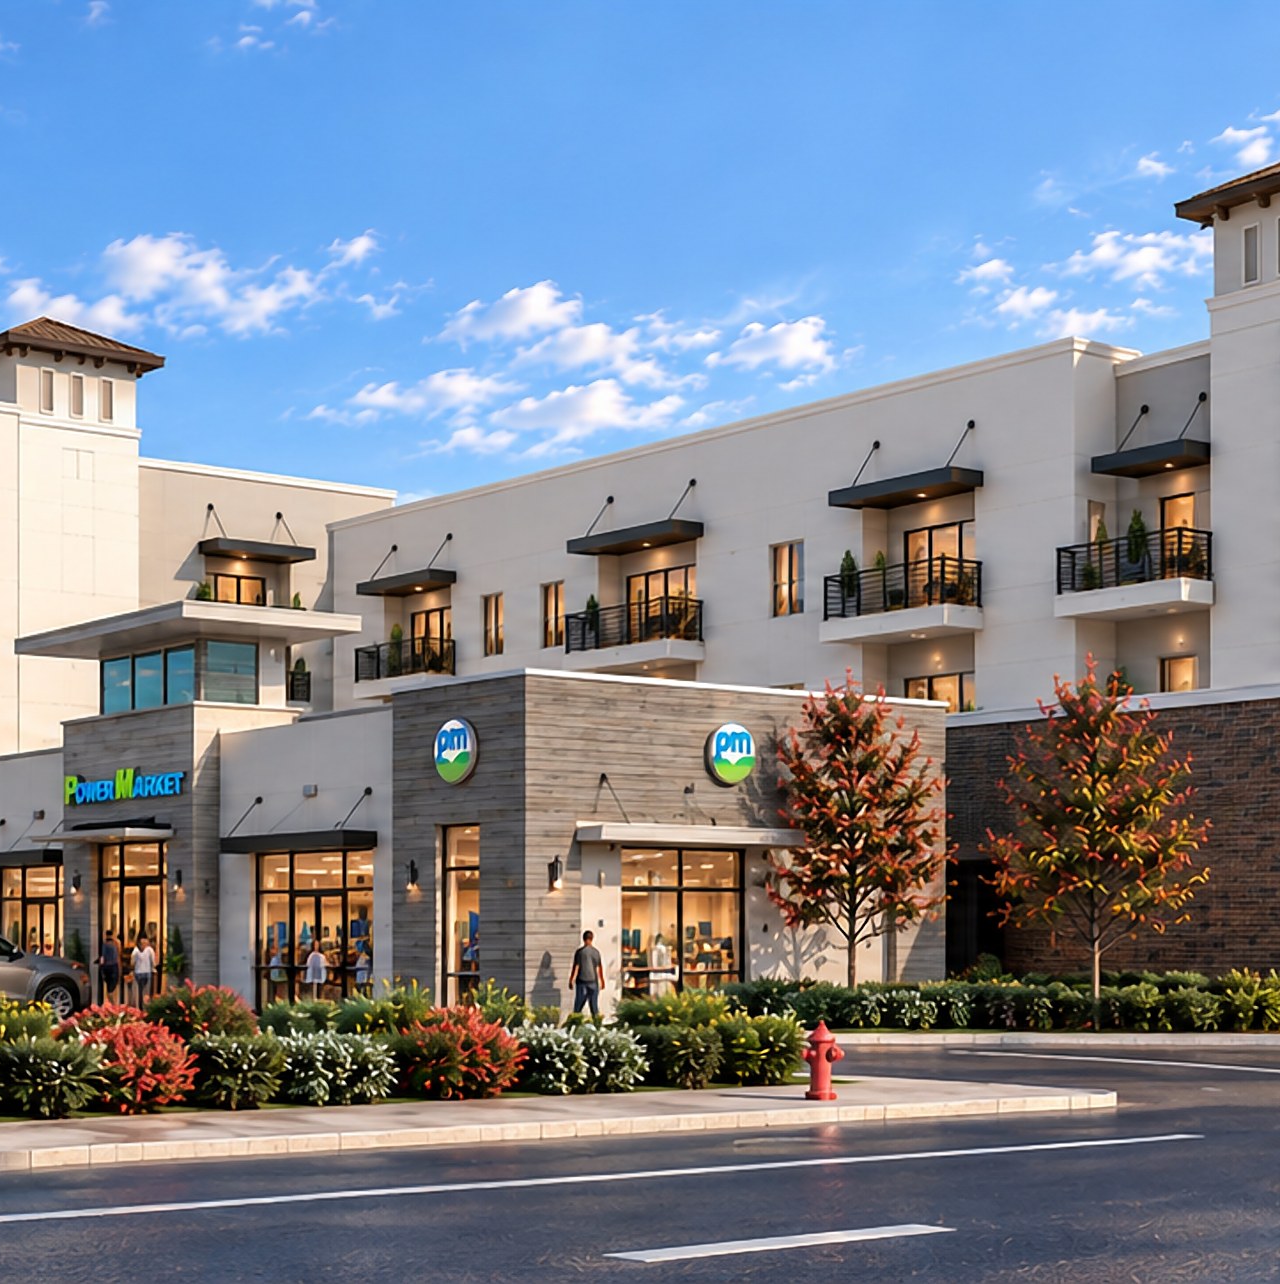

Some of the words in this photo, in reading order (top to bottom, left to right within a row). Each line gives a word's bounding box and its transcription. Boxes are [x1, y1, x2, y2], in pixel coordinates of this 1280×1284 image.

[436, 728, 467, 762] pm
[715, 731, 751, 762] pm
[115, 768, 184, 799] MARKET
